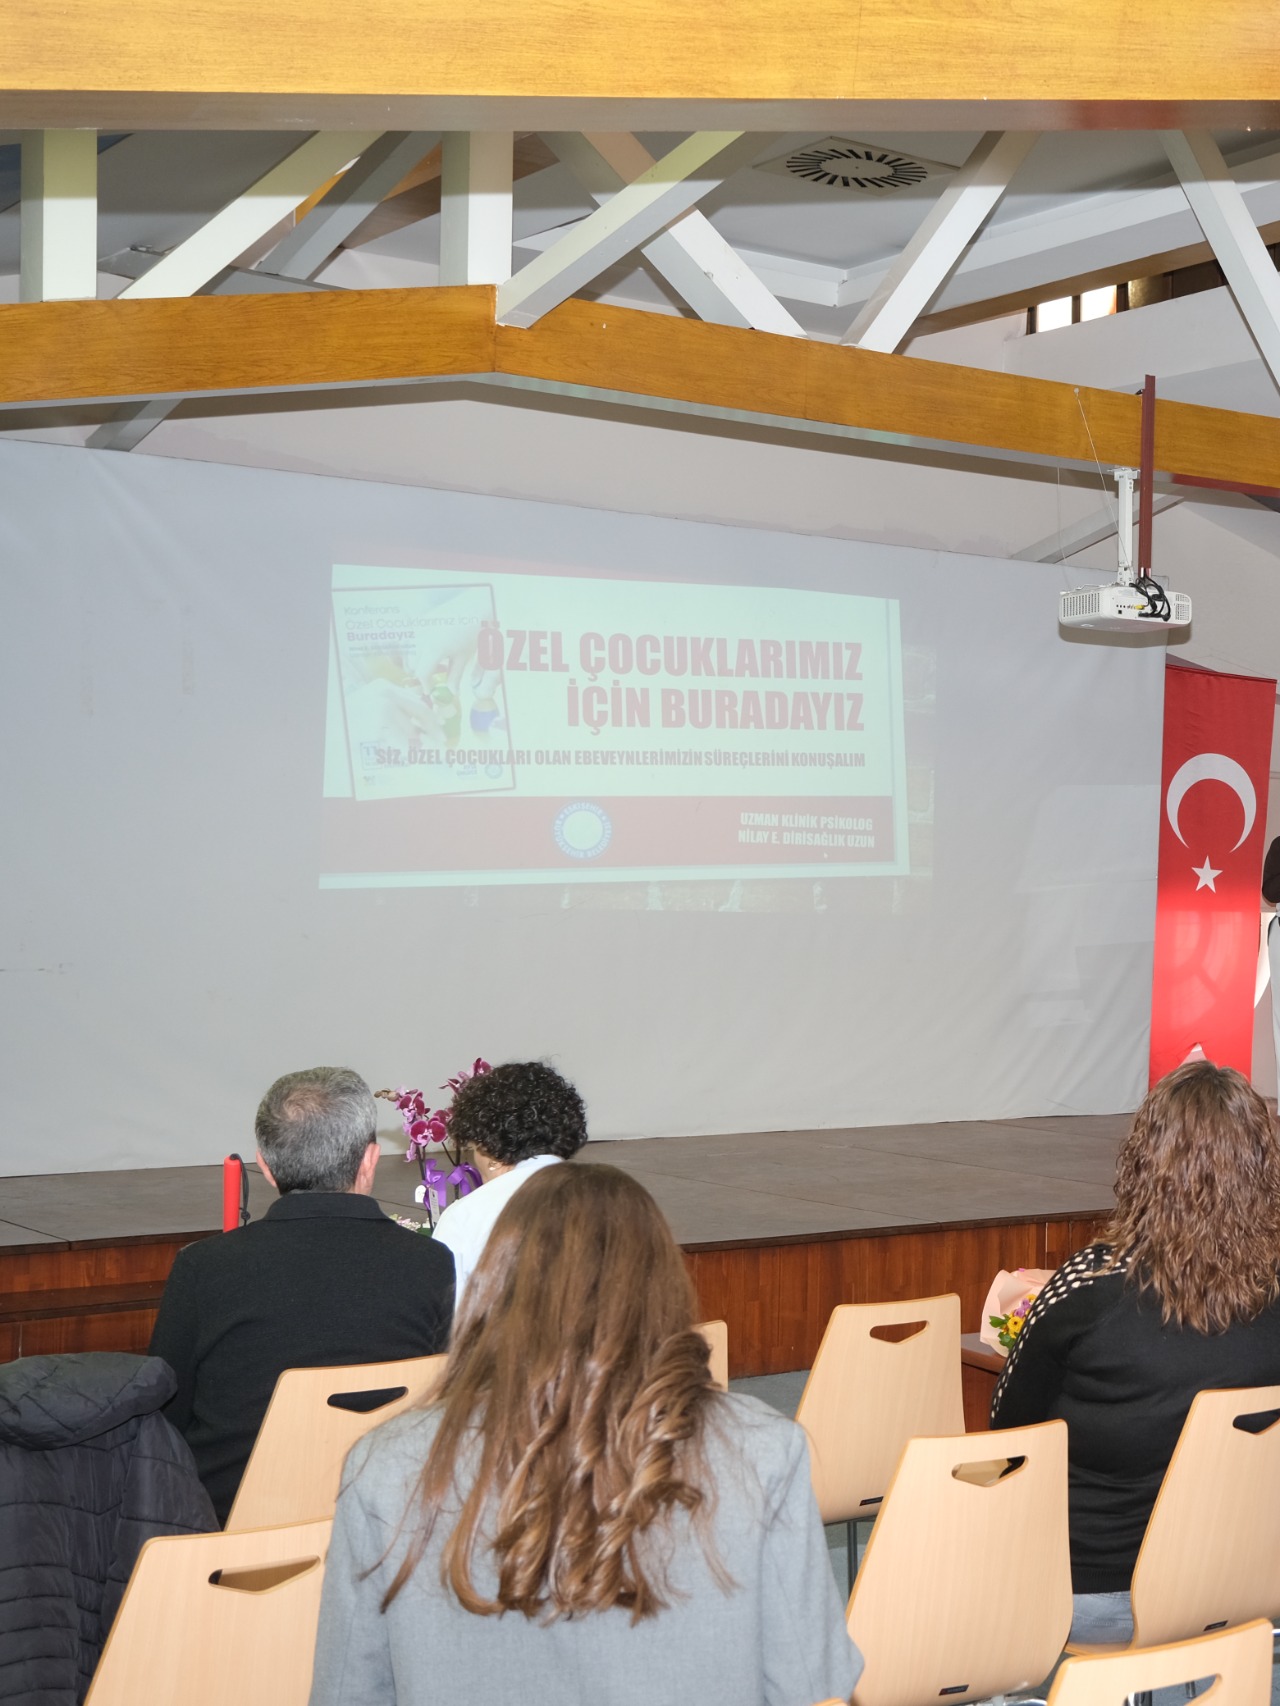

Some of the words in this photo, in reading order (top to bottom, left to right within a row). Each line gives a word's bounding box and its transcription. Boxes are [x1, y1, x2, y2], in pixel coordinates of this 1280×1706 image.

[477, 620, 570, 673] ÖZEL
[579, 631, 863, 682] ÇOCUKLARIMIZ
[567, 678, 650, 735] İÇİN
[661, 687, 865, 731] BURADAYIZ
[407, 746, 443, 766] ÖZEL
[445, 748, 532, 768] ÇOCUKLARI
[535, 750, 571, 766] OLAN
[575, 748, 703, 767] EBEVEYNLERİMİZİN
[704, 749, 789, 769] SÜREÇLERİNİ
[791, 752, 866, 770] KONUŞALIM
[740, 812, 779, 827] UZMAN
[781, 812, 818, 829] KLİNİK
[820, 815, 873, 831] PSİKOLOG
[738, 828, 770, 843] NİLAY
[846, 835, 875, 849] UZUN
